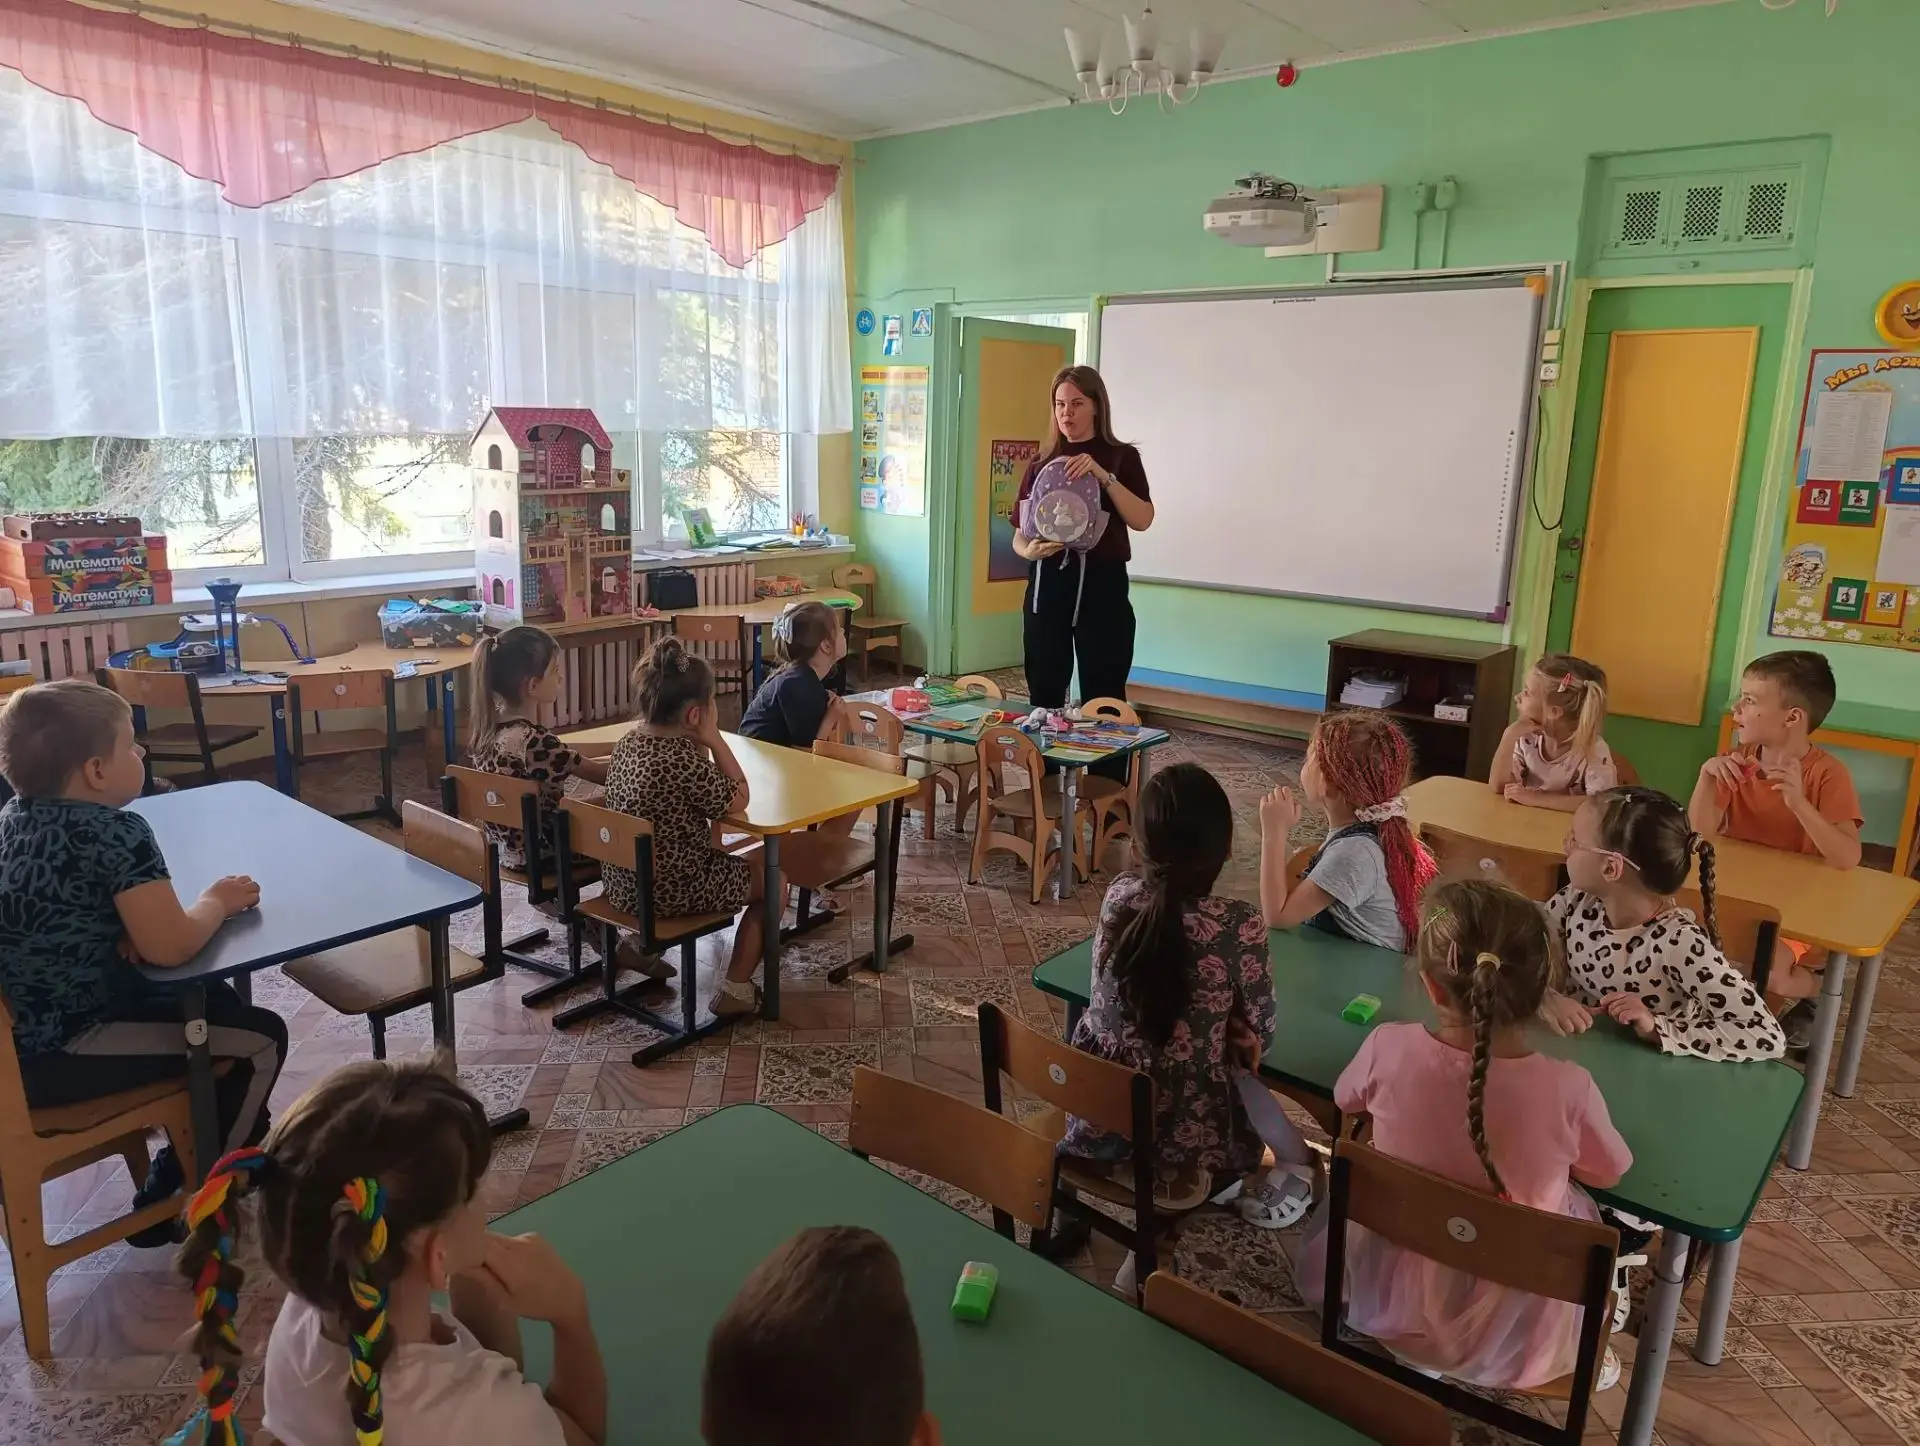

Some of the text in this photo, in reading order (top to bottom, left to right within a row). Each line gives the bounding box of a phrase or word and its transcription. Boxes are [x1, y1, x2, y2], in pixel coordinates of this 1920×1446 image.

[1824, 363, 1869, 391] Мы
[51, 555, 142, 570] Математика
[59, 588, 149, 603] Математика
[1054, 1070, 1060, 1080] 2
[1457, 1224, 1465, 1236] 2
